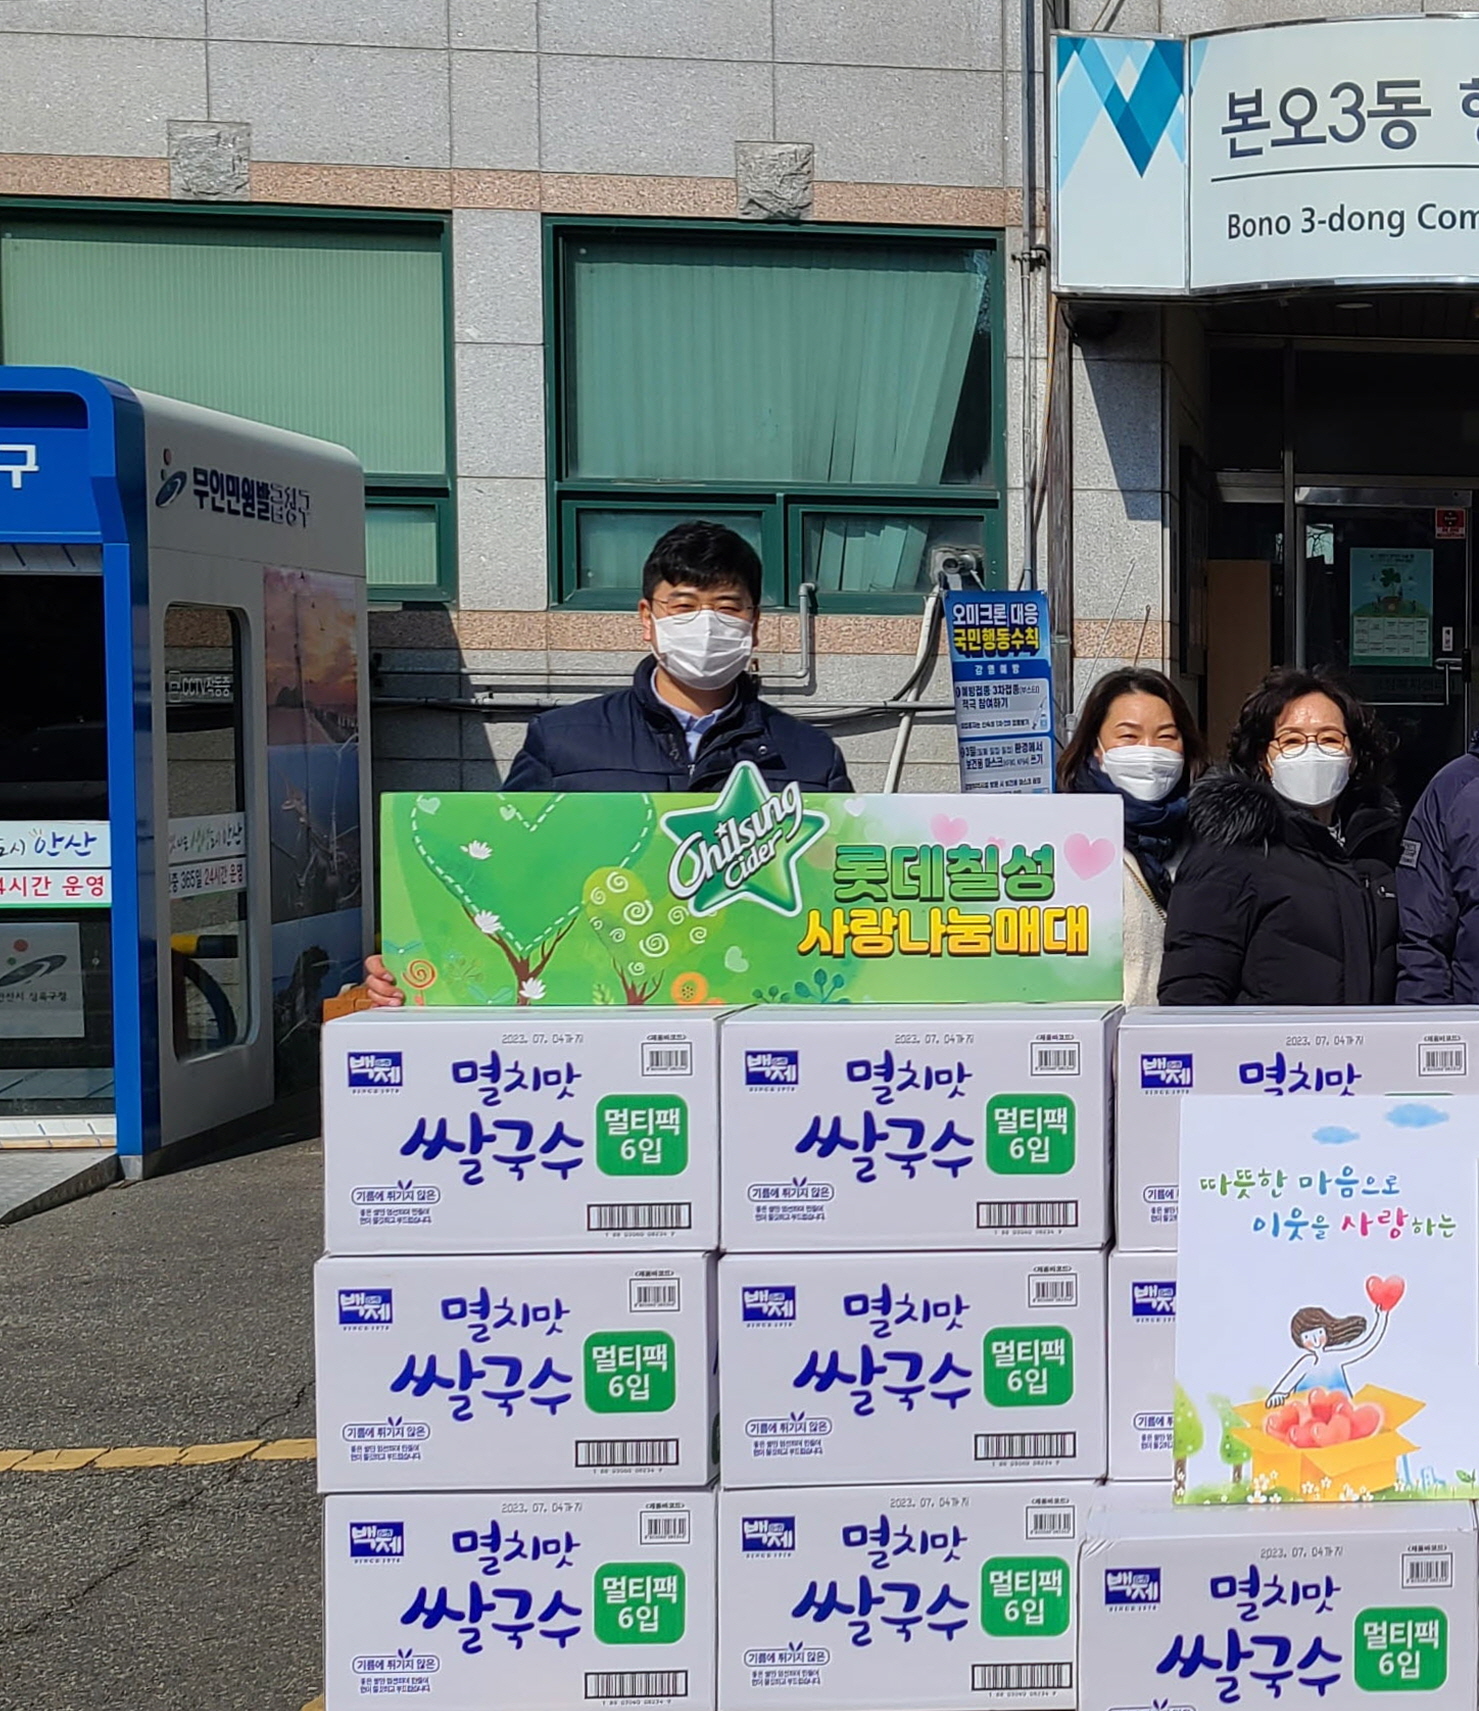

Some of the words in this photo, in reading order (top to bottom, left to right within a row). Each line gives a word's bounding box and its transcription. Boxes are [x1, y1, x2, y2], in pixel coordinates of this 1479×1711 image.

[1221, 77, 1431, 162] 본오3동
[1227, 212, 1291, 241] Bono
[1301, 203, 1405, 240] 3-dong
[953, 603, 1007, 625] 오미크론
[1010, 602, 1039, 626] 대응
[953, 626, 1041, 652] 국민행동수칙
[34, 831, 97, 857] 안산
[669, 781, 802, 899] Chilsung
[722, 827, 782, 890] Cider
[834, 843, 1057, 902] 롯데칠성
[62, 875, 104, 897] 운영
[797, 905, 1091, 958] 사랑나눔매대
[451, 1050, 582, 1107] 멸치맛
[846, 1048, 973, 1105] 멸치맛
[603, 1107, 682, 1136] 멀티팩
[993, 1107, 1069, 1135] 멀티팩
[400, 1111, 585, 1186] 쌀국수
[619, 1138, 662, 1165] 6입
[795, 1110, 975, 1184] 쌀국수
[1008, 1136, 1050, 1164] 6입
[1200, 1168, 1288, 1200] 따뜻한
[1298, 1166, 1402, 1198] 마음으로
[1253, 1208, 1327, 1242] 이웃을
[1340, 1207, 1458, 1240] 사랑하는
[441, 1286, 570, 1343] 멸치맛
[843, 1283, 970, 1338] 멸치맛
[592, 1343, 669, 1373] 멀티팩
[991, 1339, 1066, 1367] 멀티팩
[389, 1348, 573, 1422] 쌀국수
[607, 1374, 650, 1402] 6입
[793, 1344, 973, 1417] 쌀국수
[1006, 1368, 1049, 1395] 6입
[452, 1519, 582, 1576] 멸치맛
[842, 1514, 968, 1569] 멸치맛
[602, 1576, 678, 1605] 멀티팩
[989, 1569, 1064, 1597] 멀티팩
[1210, 1564, 1341, 1622] 멸치맛
[400, 1581, 584, 1654] 쌀국수
[617, 1606, 659, 1633] 6입
[792, 1575, 970, 1647] 쌀국수
[1003, 1599, 1045, 1625] 6입
[1363, 1620, 1440, 1650] 멀티팩
[1156, 1628, 1343, 1703] 쌀국수
[1378, 1650, 1421, 1679] 6입
